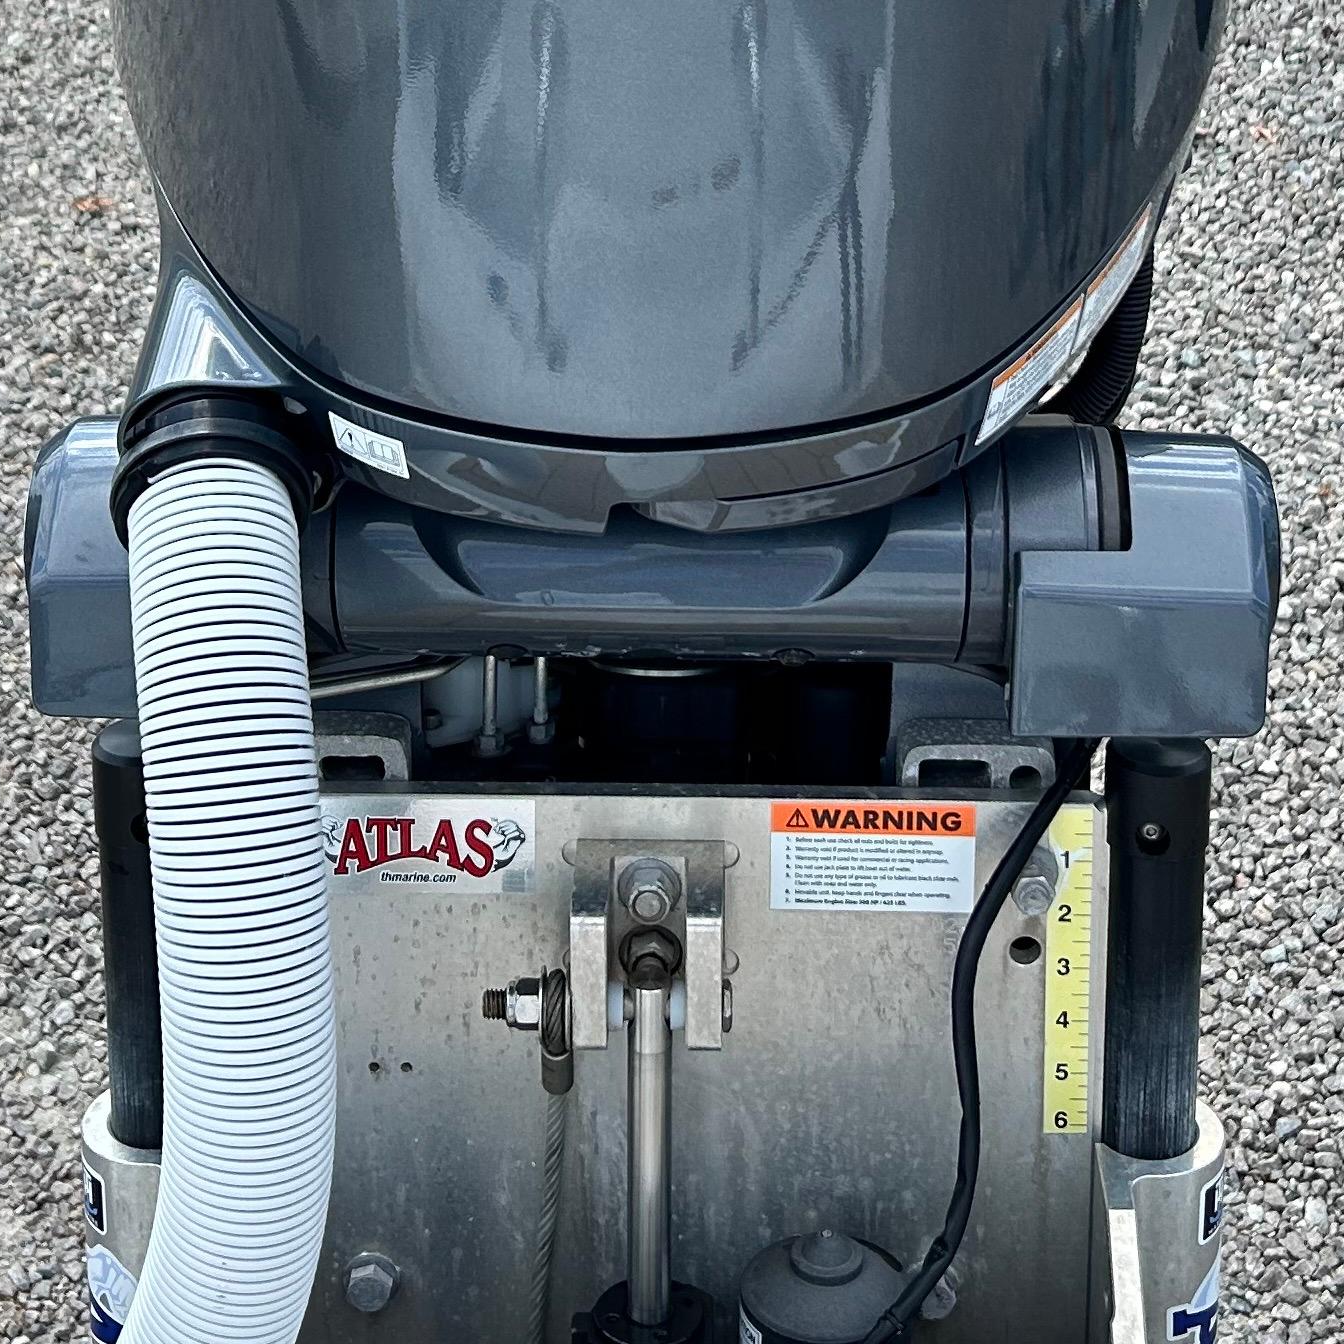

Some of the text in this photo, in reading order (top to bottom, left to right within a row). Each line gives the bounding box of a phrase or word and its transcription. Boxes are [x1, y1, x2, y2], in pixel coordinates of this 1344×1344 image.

[810, 808, 962, 832] WARNING
[333, 816, 495, 878] ATLAS
[1061, 850, 1070, 868] 1
[380, 871, 457, 883] thmarine.com
[1058, 904, 1072, 923] 2
[1056, 957, 1071, 976] 3
[1055, 1010, 1070, 1029] 4
[1054, 1063, 1069, 1081] 5
[1054, 1111, 1068, 1129] 6
